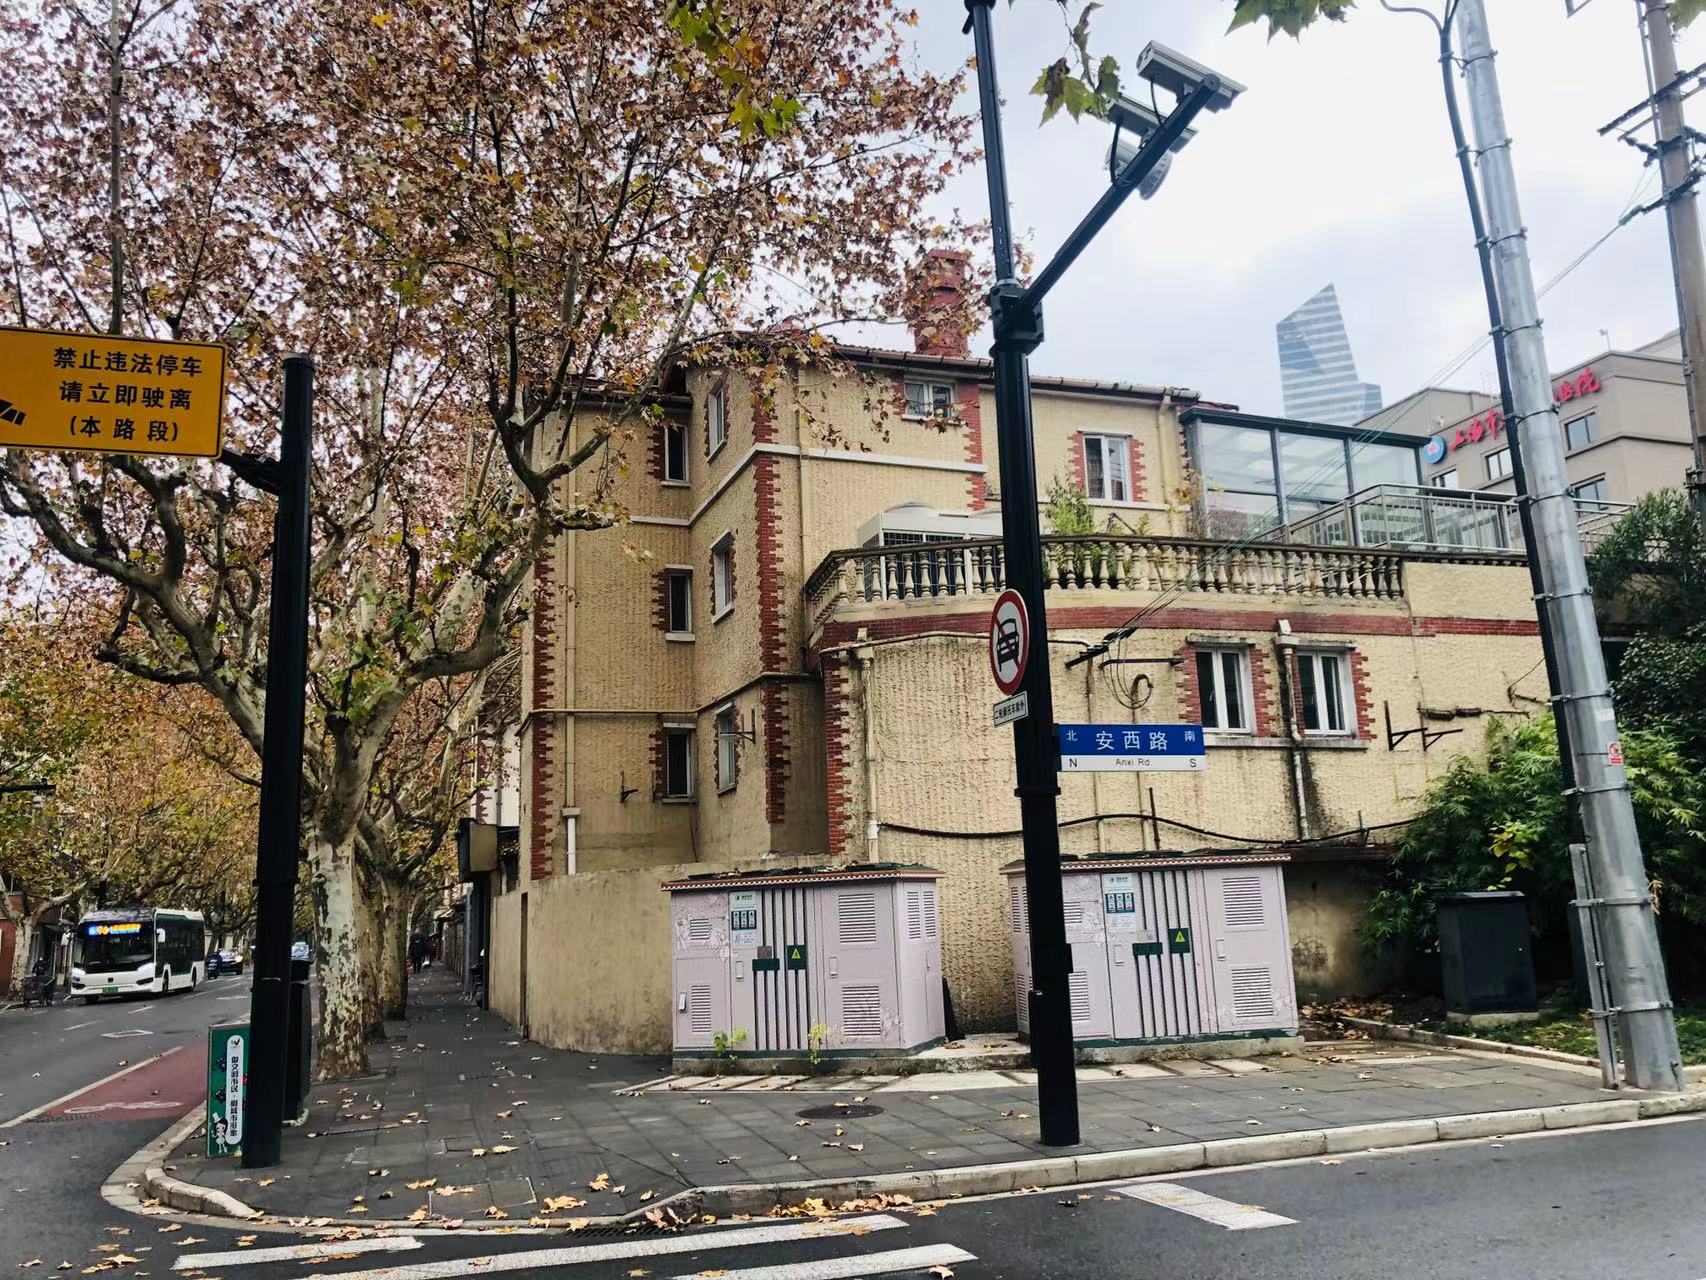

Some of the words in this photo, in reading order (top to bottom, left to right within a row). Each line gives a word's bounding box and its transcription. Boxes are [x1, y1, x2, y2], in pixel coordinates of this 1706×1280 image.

[53, 347, 202, 377] 禁止违法停车
[59, 381, 192, 410] 请立即驶离
[1449, 407, 1504, 453] 上海市
[1553, 367, 1601, 402] 医院
[69, 415, 178, 442] (本路段)
[1066, 729, 1078, 742] 北
[1095, 730, 1168, 751] 安西路
[1184, 729, 1196, 742] 南
[1069, 758, 1077, 768] N
[1115, 757, 1135, 766] Anxi
[1189, 758, 1197, 768] S
